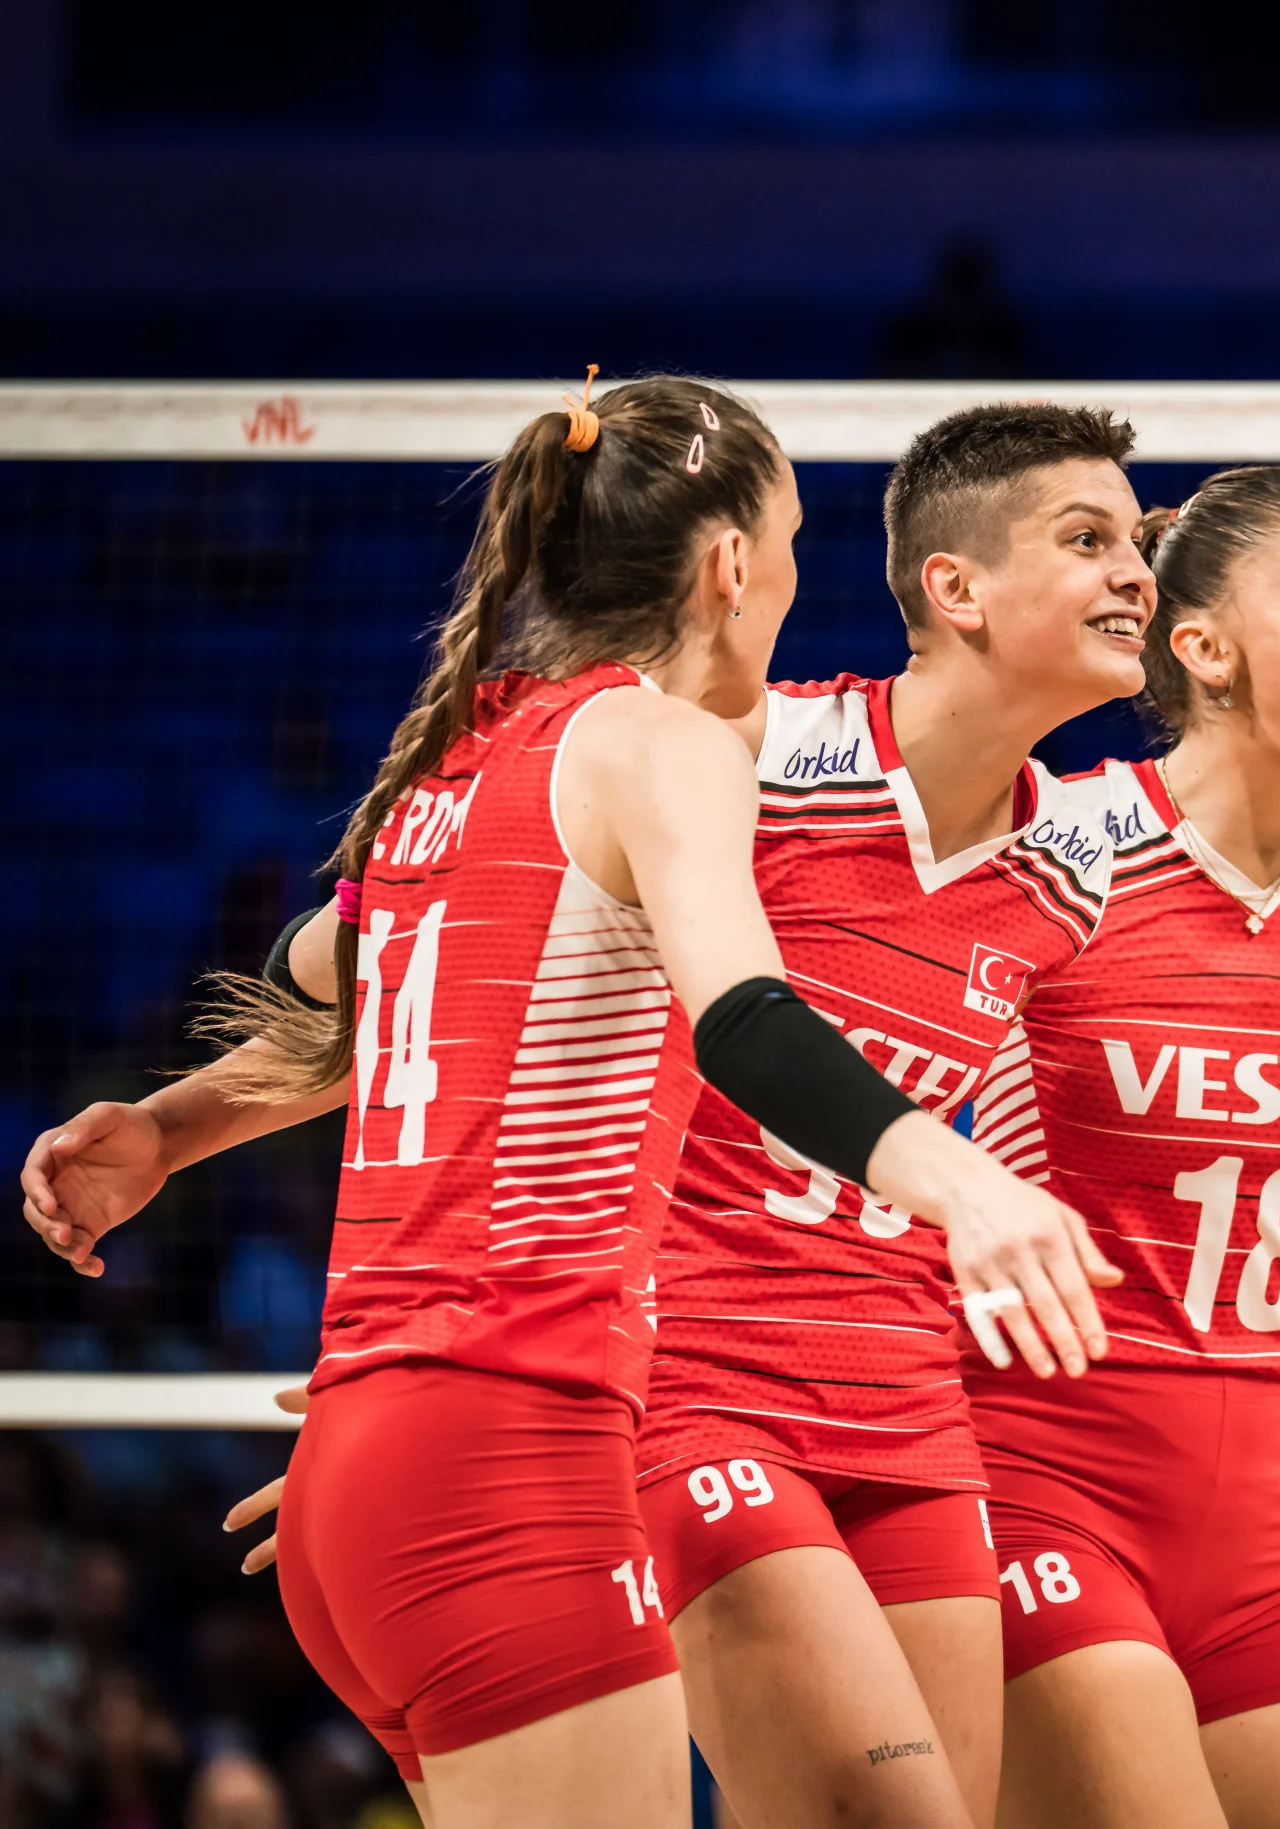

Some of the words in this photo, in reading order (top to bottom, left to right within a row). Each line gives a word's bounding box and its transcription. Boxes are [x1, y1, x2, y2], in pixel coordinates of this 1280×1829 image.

[784, 738, 860, 779] Orkid
[1033, 819, 1103, 875] Orkid
[353, 900, 448, 1170] 14
[980, 994, 1008, 1016] TUR
[687, 1459, 775, 1524] 99
[611, 1555, 665, 1626] 14
[999, 1551, 1081, 1615] 18
